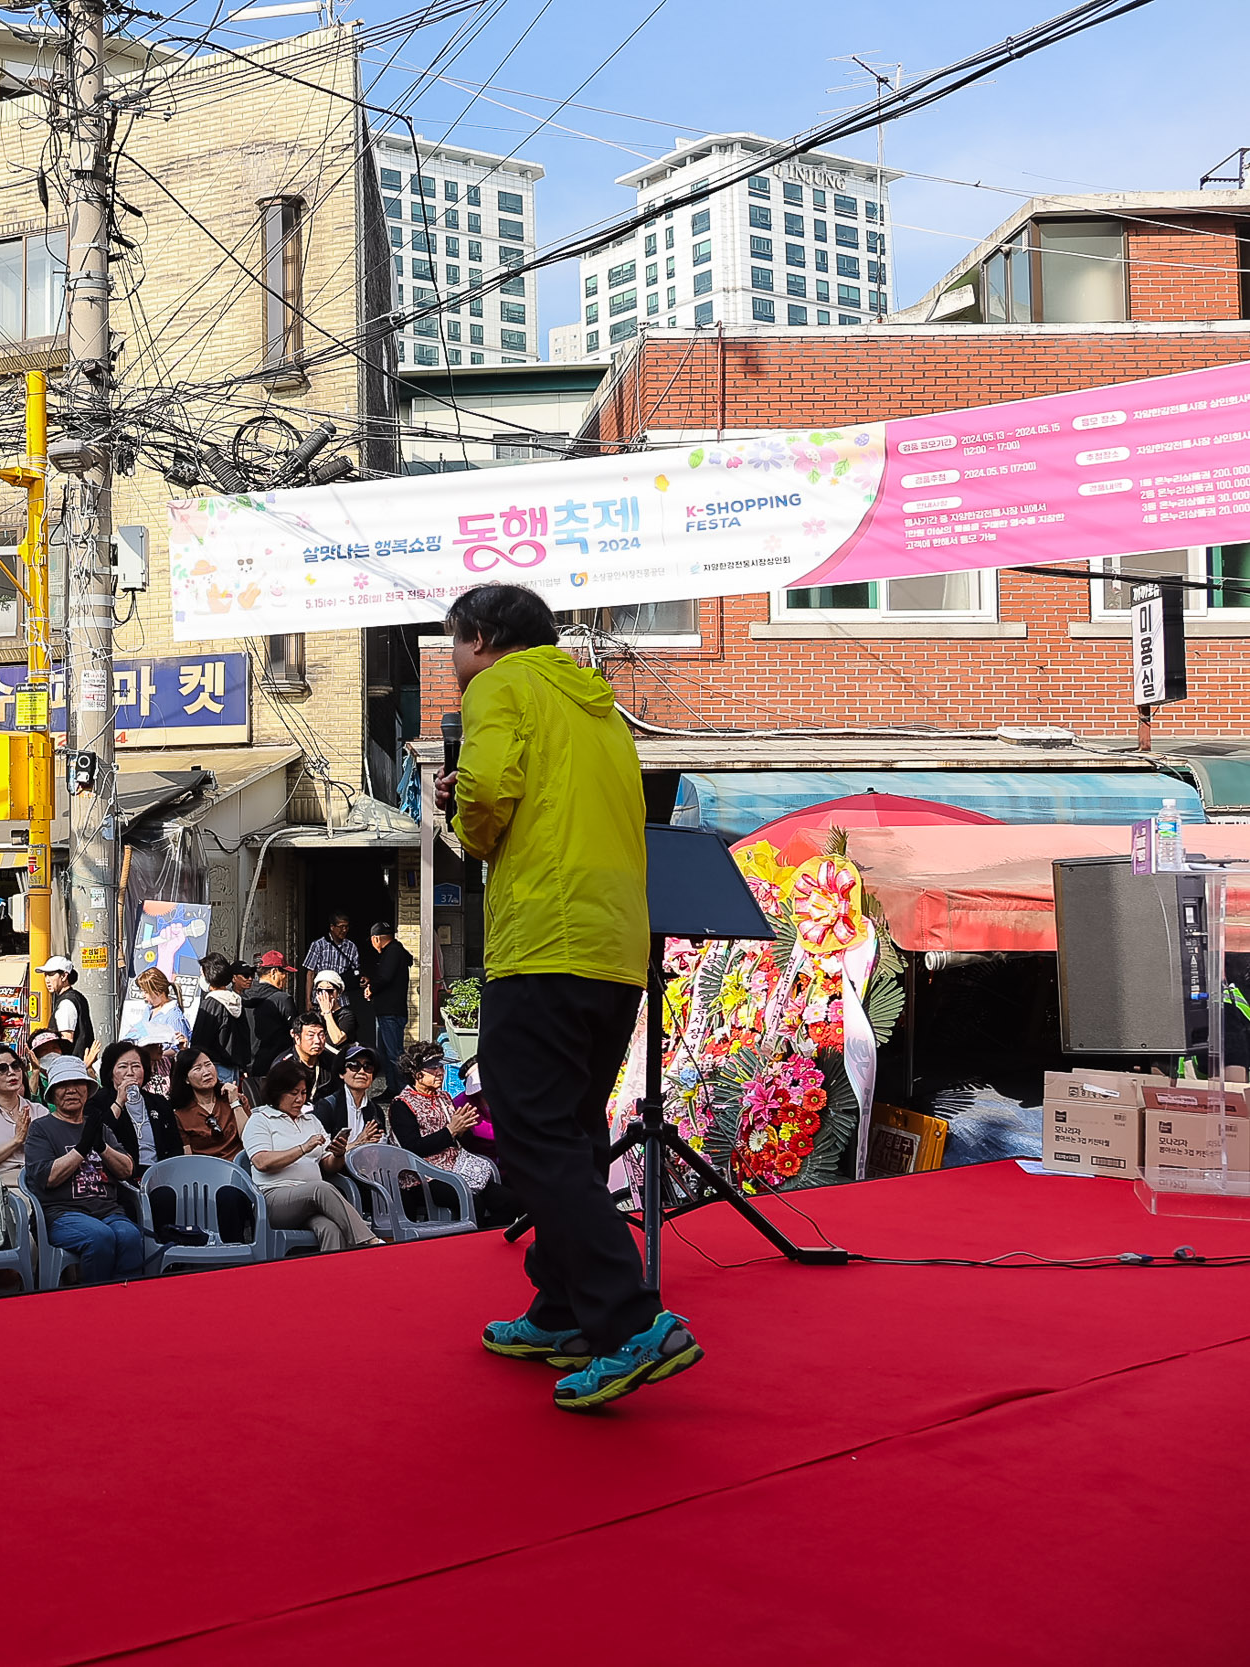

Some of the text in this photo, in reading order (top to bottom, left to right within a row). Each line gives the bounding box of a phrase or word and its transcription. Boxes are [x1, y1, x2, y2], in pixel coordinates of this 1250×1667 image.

[788, 163, 847, 191] INJUNG
[961, 430, 1005, 445] 2024.05.13
[1015, 422, 1061, 437] 2024.05.15
[964, 466, 1008, 480] 2024.05.15
[686, 493, 802, 518] K-SHOPPING
[453, 496, 640, 573] 동행축제
[686, 516, 742, 533] FESTA
[302, 535, 442, 564] 살맛나는 행복쇼핑
[597, 536, 642, 553] 2024
[385, 591, 405, 603] 전국
[1140, 603, 1156, 698] 미용실
[175, 975, 199, 985] 2024
[1158, 1137, 1188, 1147] 모나리자
